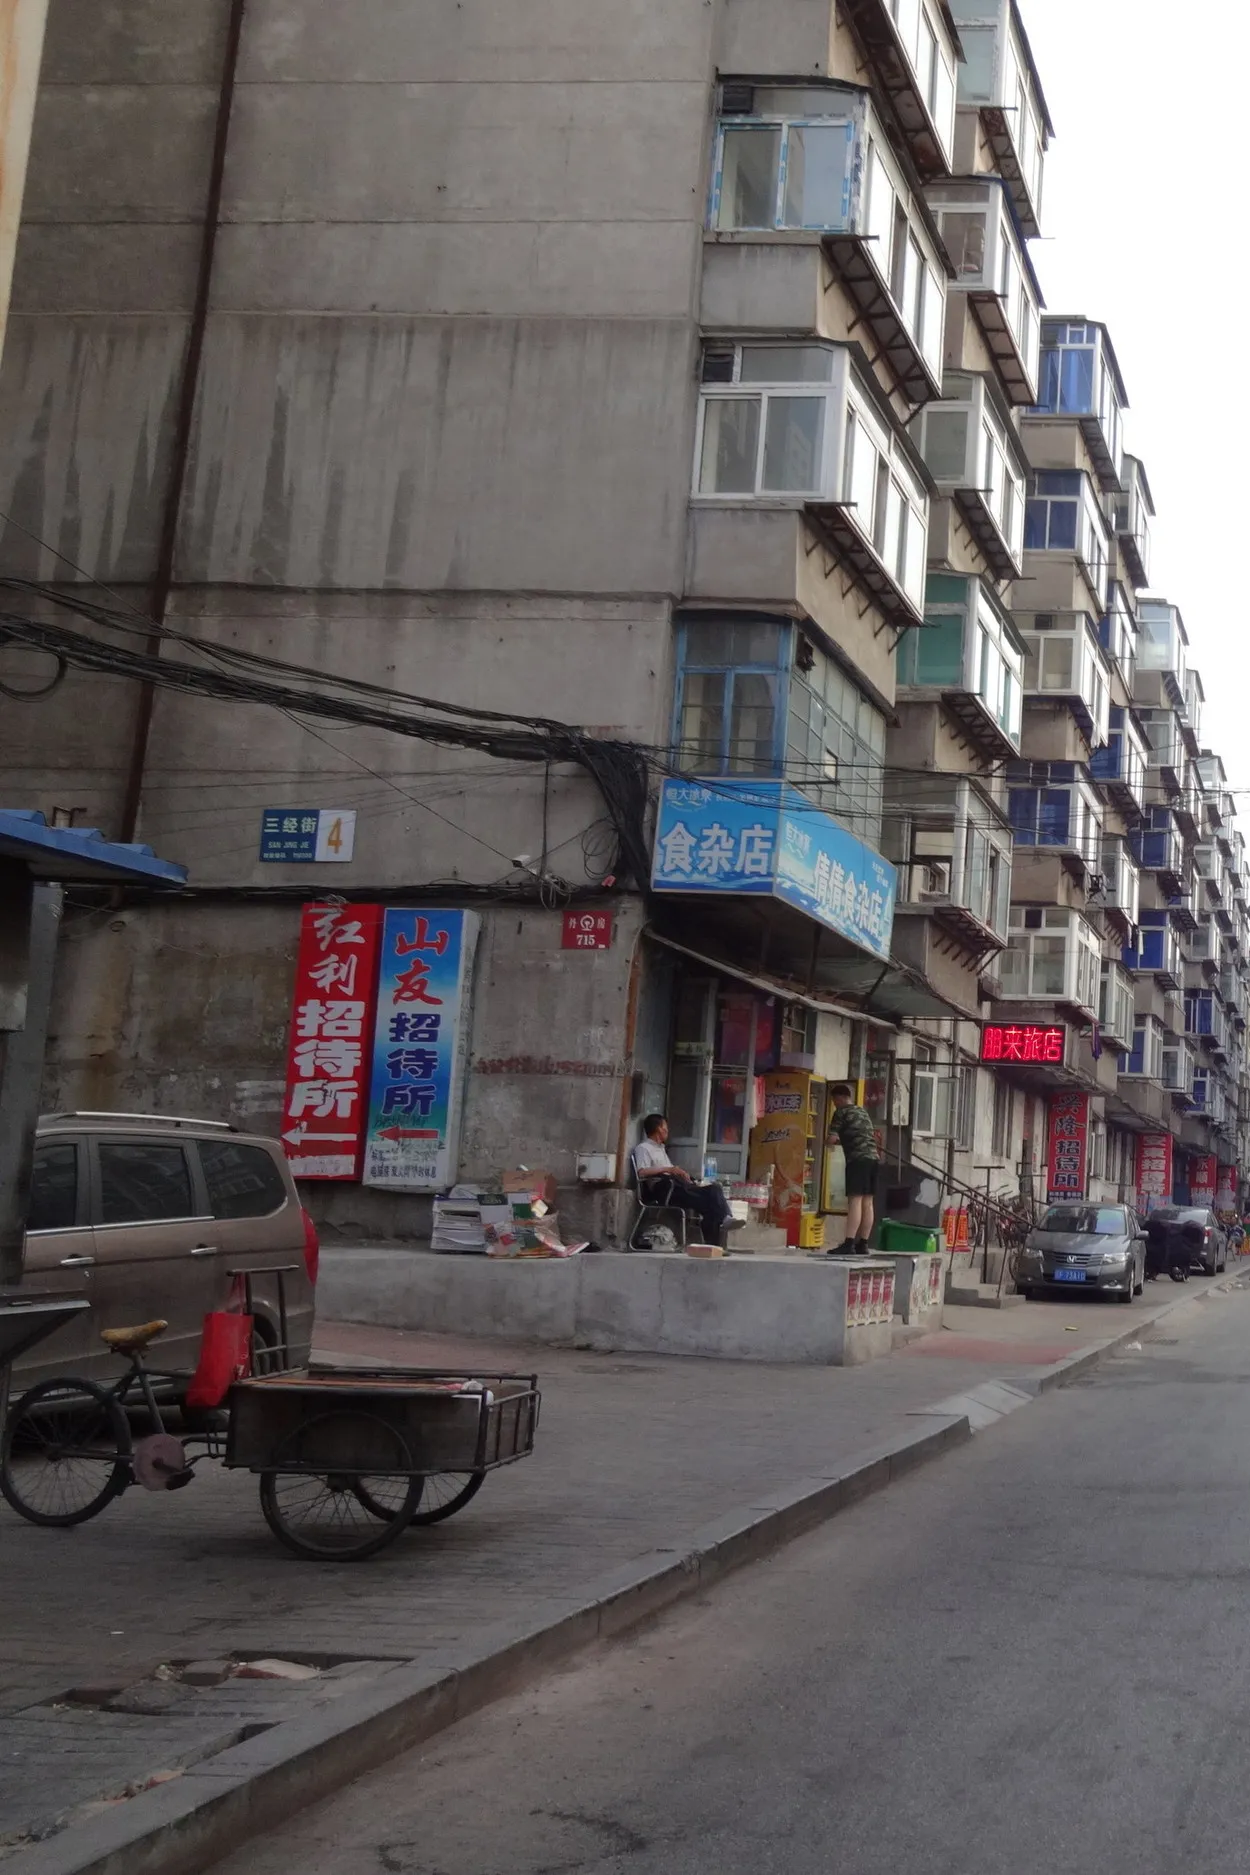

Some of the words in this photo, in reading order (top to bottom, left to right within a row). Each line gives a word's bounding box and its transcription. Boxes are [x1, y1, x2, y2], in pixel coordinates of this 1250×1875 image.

[263, 816, 317, 834] 三经街
[327, 816, 343, 855] 4
[660, 821, 774, 875] 食杂店
[576, 934, 596, 946] 715
[287, 907, 366, 1118] 红利招待所
[381, 915, 450, 1117] 山友招待所
[982, 1026, 1063, 1062] 朋来旅店
[1052, 1094, 1087, 1188] 兴隆招待所
